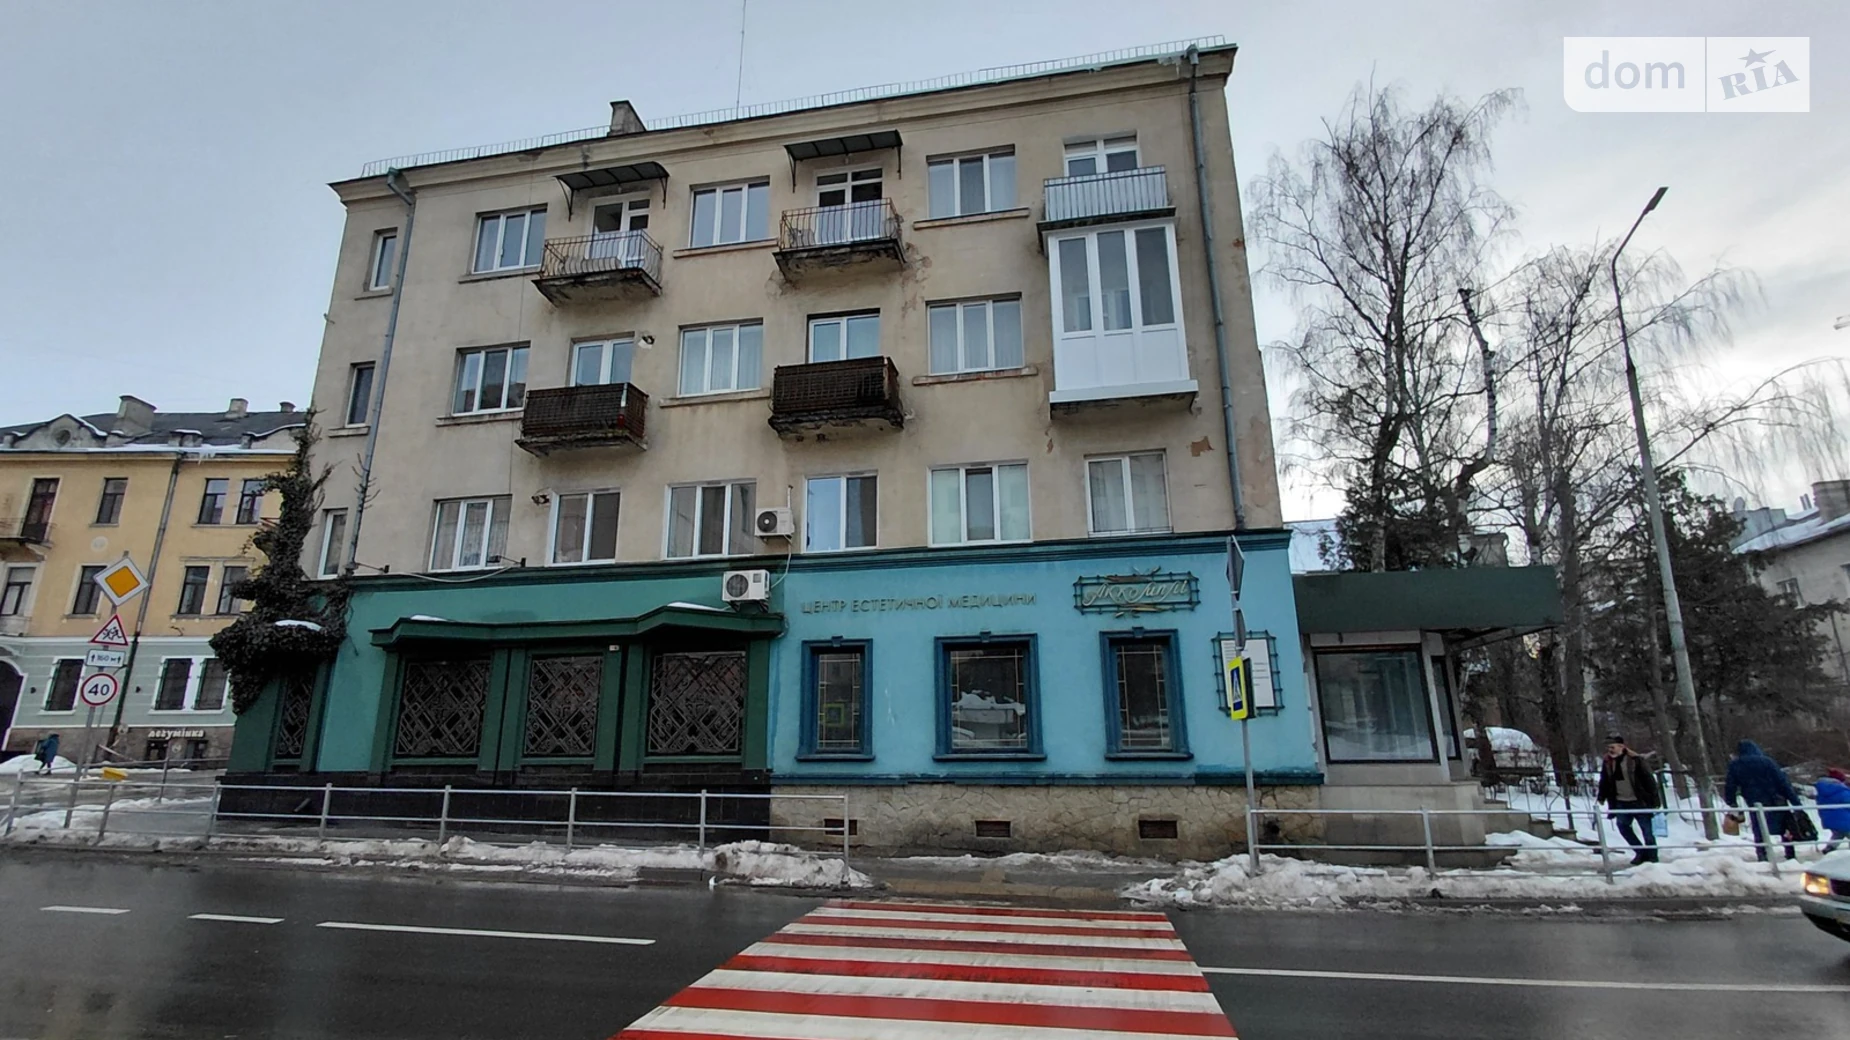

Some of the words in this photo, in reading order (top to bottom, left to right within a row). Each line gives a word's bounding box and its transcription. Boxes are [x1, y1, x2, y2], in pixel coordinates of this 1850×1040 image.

[802, 599, 848, 615] ЦЕНТР
[947, 592, 1038, 610] МЕДИЦИНИ
[88, 683, 110, 696] 40
